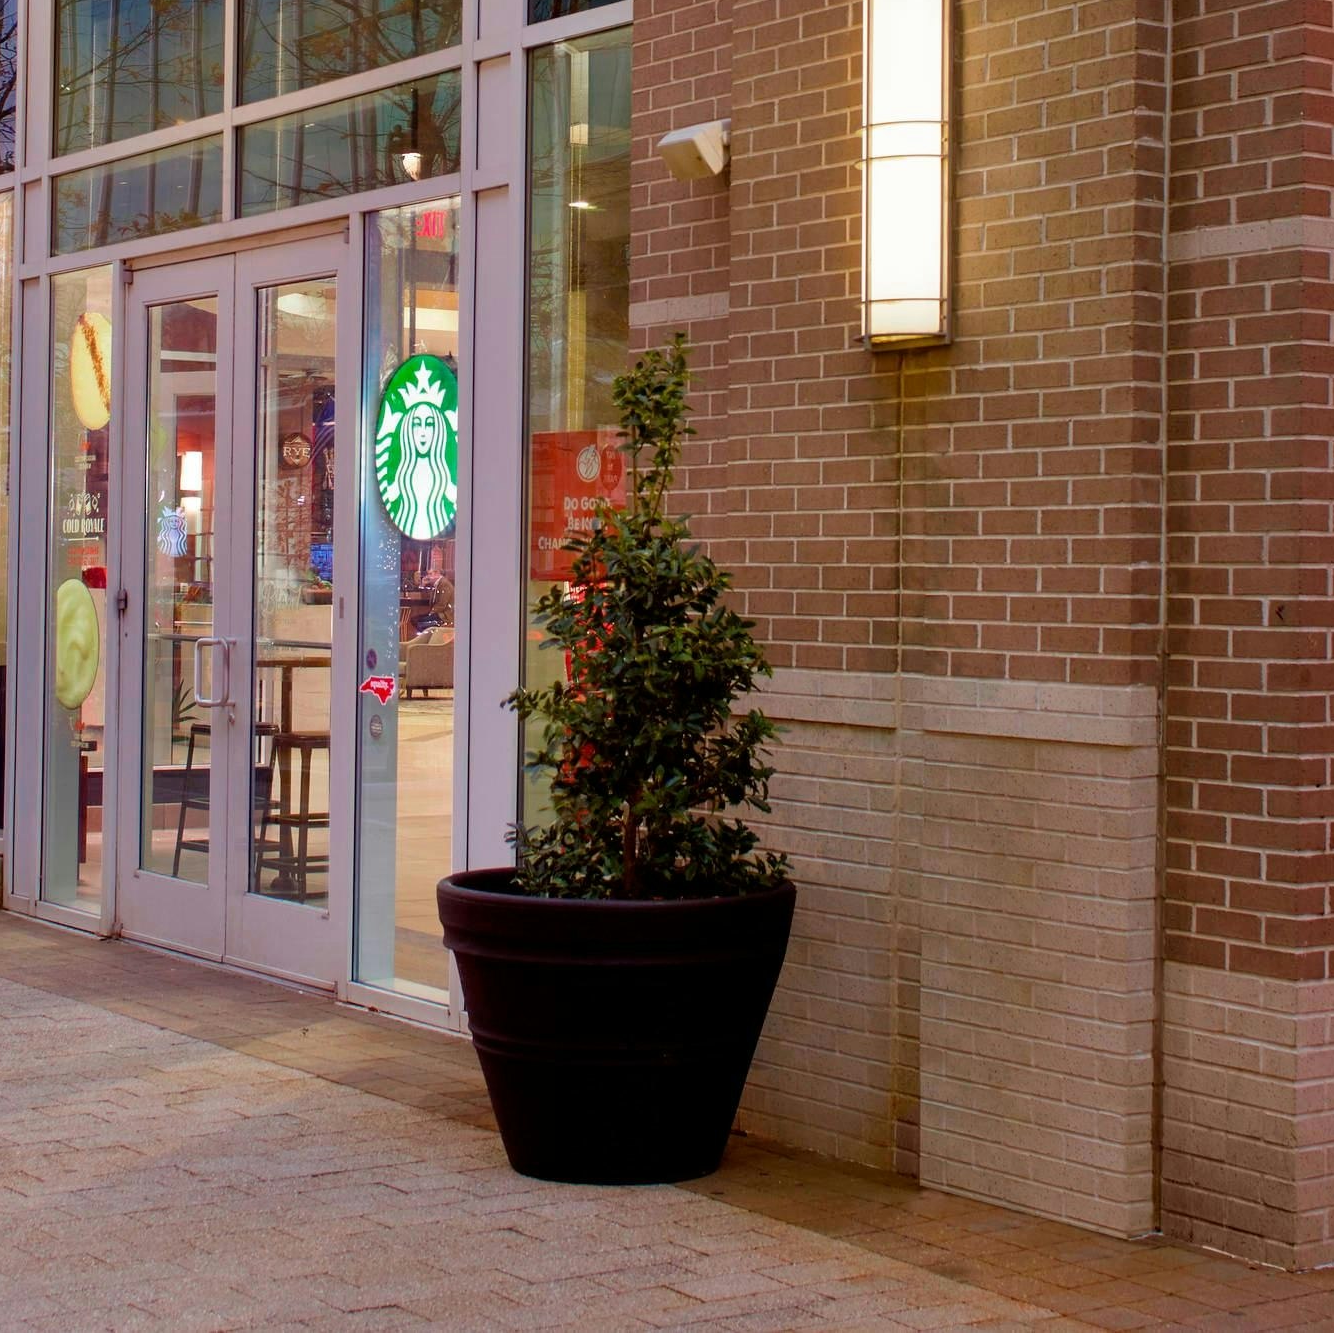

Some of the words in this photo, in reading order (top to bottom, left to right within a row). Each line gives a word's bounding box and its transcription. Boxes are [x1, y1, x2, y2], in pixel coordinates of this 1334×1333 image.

[282, 446, 311, 458] RYE
[564, 496, 578, 510] DO
[62, 518, 80, 534] COLD
[81, 517, 105, 536] ROYALE
[568, 516, 580, 530] BE
[581, 516, 609, 531] KI.
[538, 536, 578, 550] CHAN
